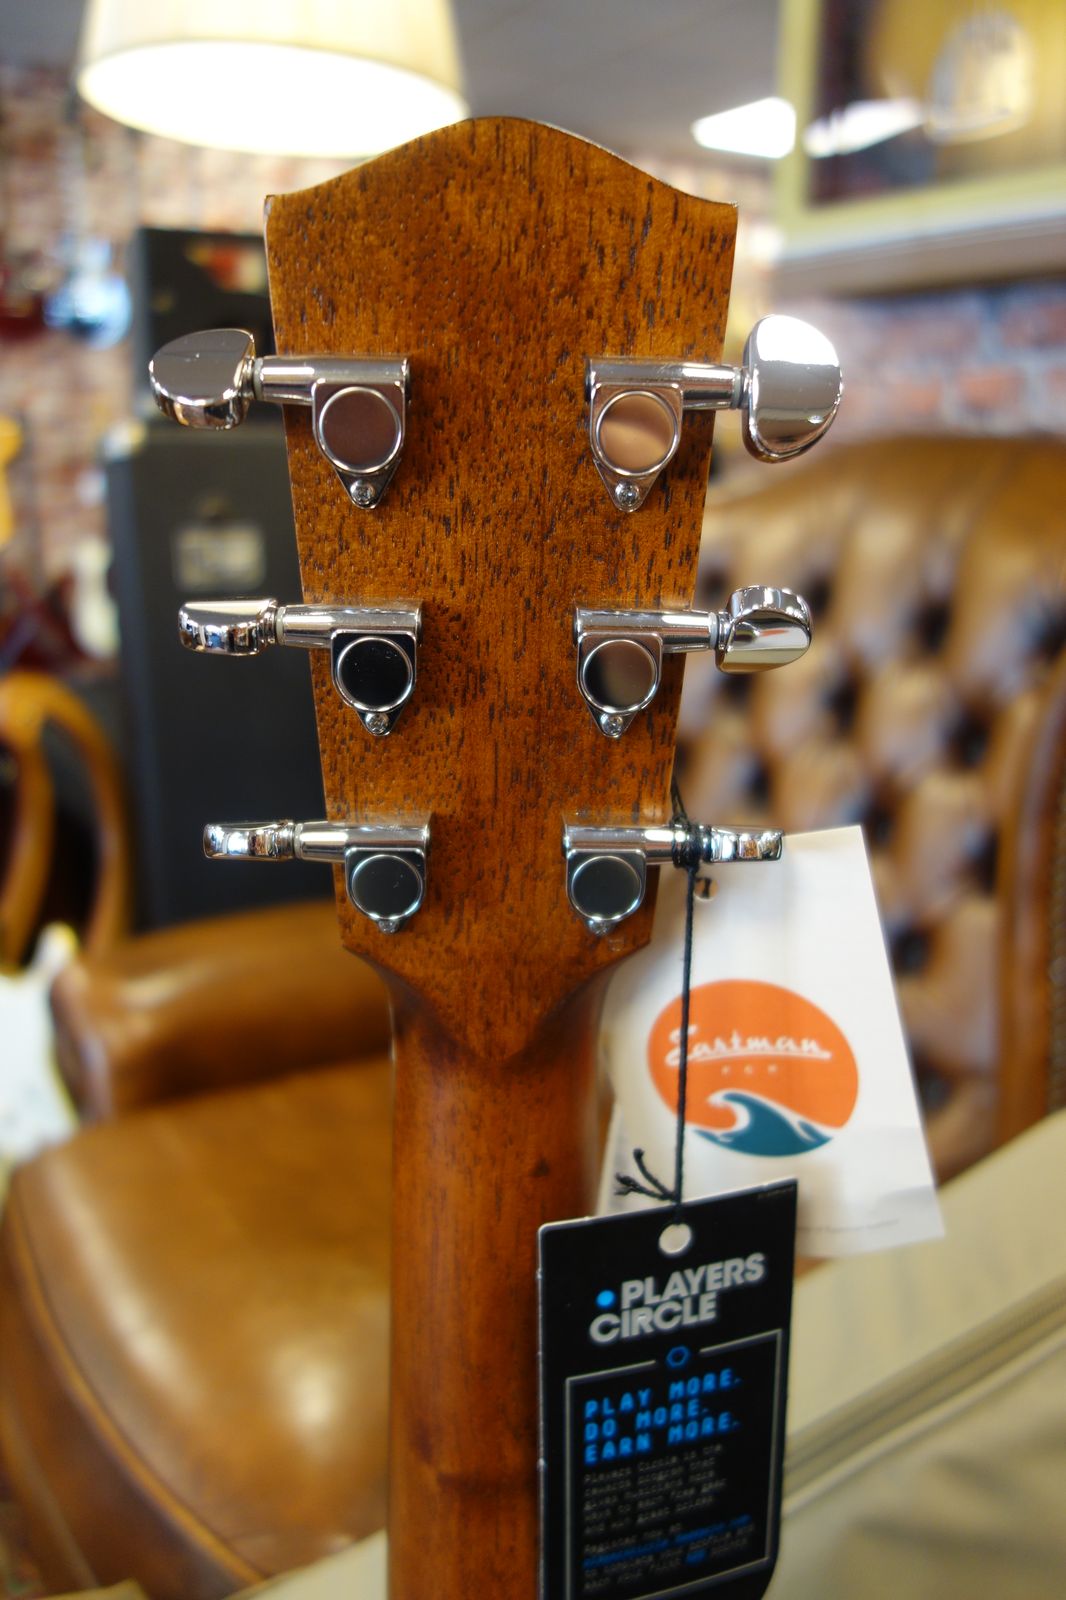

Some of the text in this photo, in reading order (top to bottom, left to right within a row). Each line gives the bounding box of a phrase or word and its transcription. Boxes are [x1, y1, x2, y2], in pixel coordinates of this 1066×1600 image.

[620, 1252, 766, 1310] PLAYERS
[589, 1291, 718, 1343] CIRCLE
[584, 1387, 652, 1420] PLAY
[584, 1418, 617, 1442] DO
[584, 1433, 652, 1466] EARN
